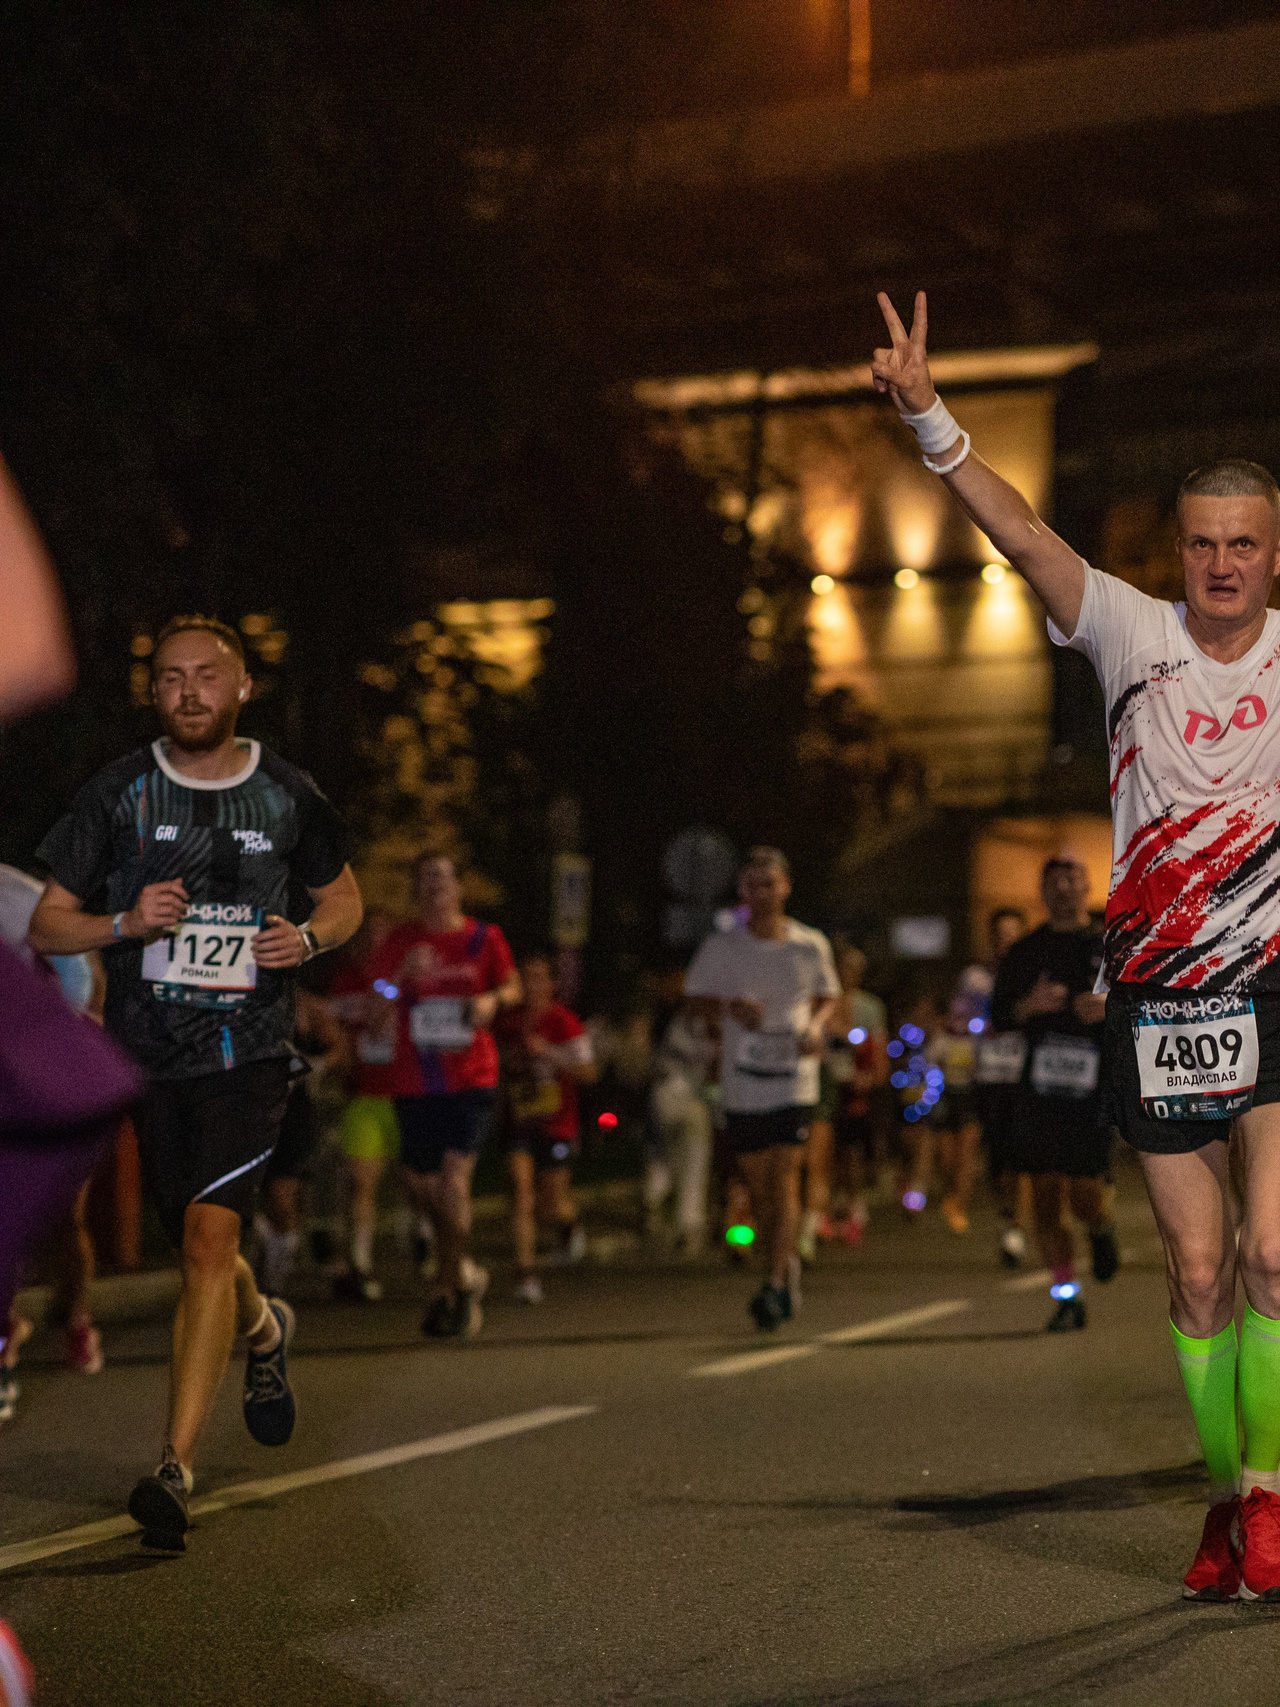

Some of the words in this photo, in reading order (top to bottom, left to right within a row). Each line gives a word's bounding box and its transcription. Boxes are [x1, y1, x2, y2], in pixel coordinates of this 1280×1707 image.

[167, 932, 245, 967] 1127
[180, 966, 219, 980] РОМАН
[1154, 1028, 1243, 1072] 4809
[1166, 1071, 1237, 1087] ВЛАДИСЛАВ
